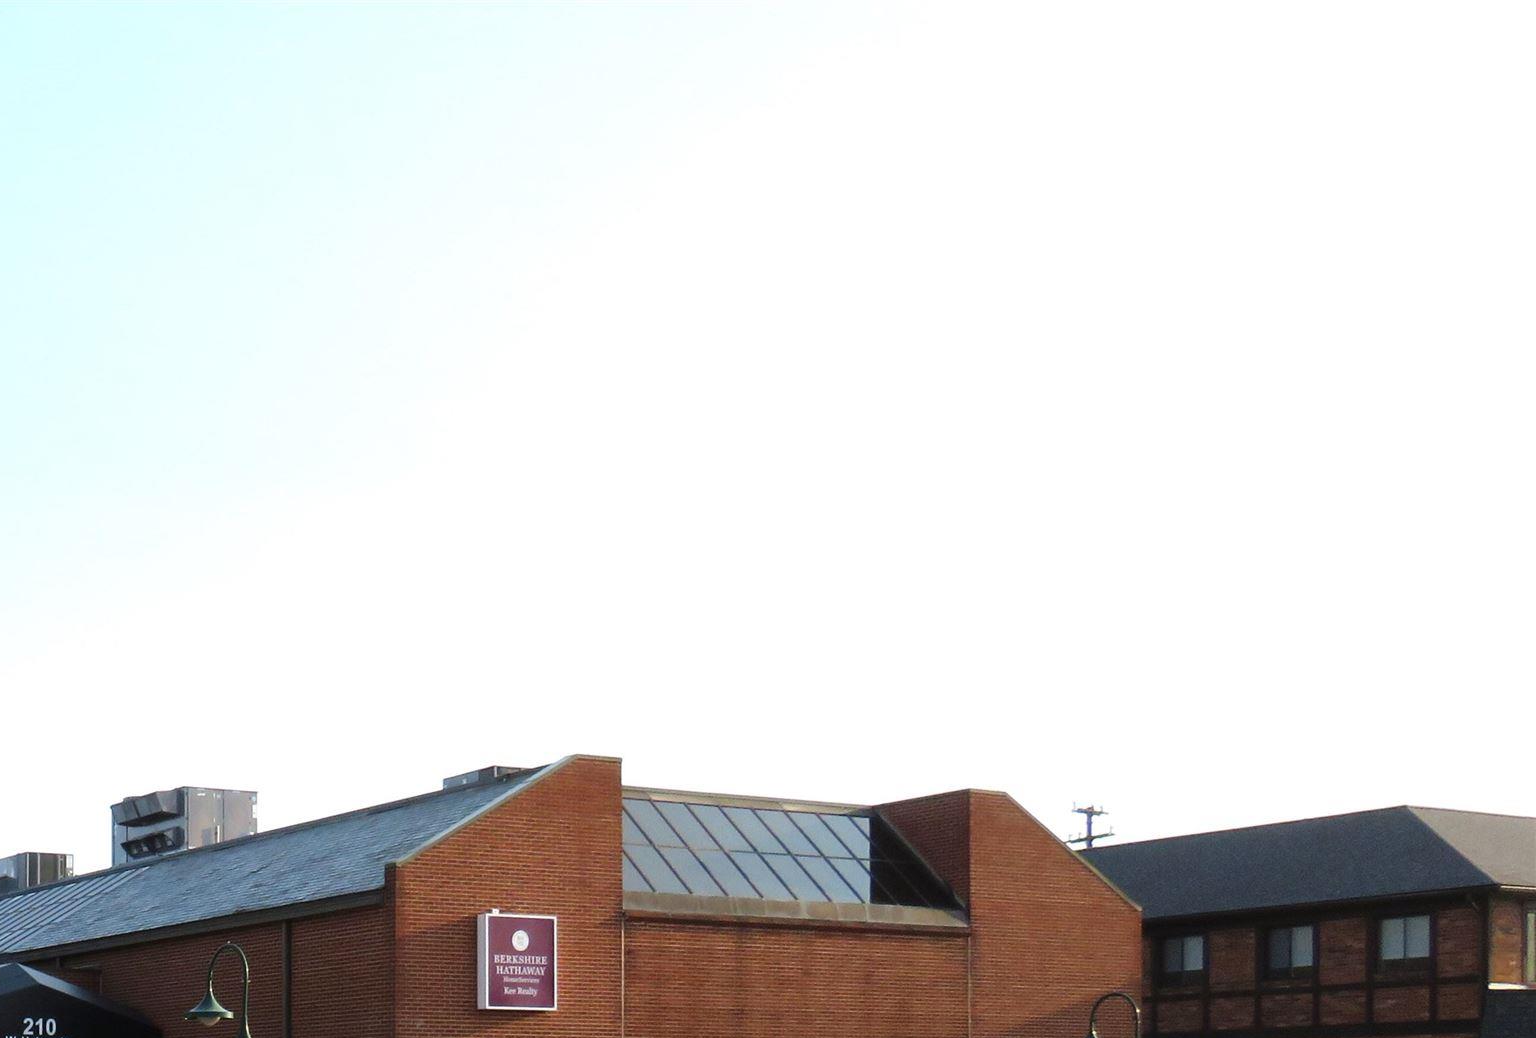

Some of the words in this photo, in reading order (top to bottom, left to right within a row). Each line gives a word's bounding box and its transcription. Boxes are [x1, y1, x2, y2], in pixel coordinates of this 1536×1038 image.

[493, 954, 548, 965] BERKSHIRE
[496, 965, 546, 976] HATHAWAY
[503, 986, 517, 995] Kee
[517, 987, 539, 997] Realty
[22, 1017, 57, 1036] 210
